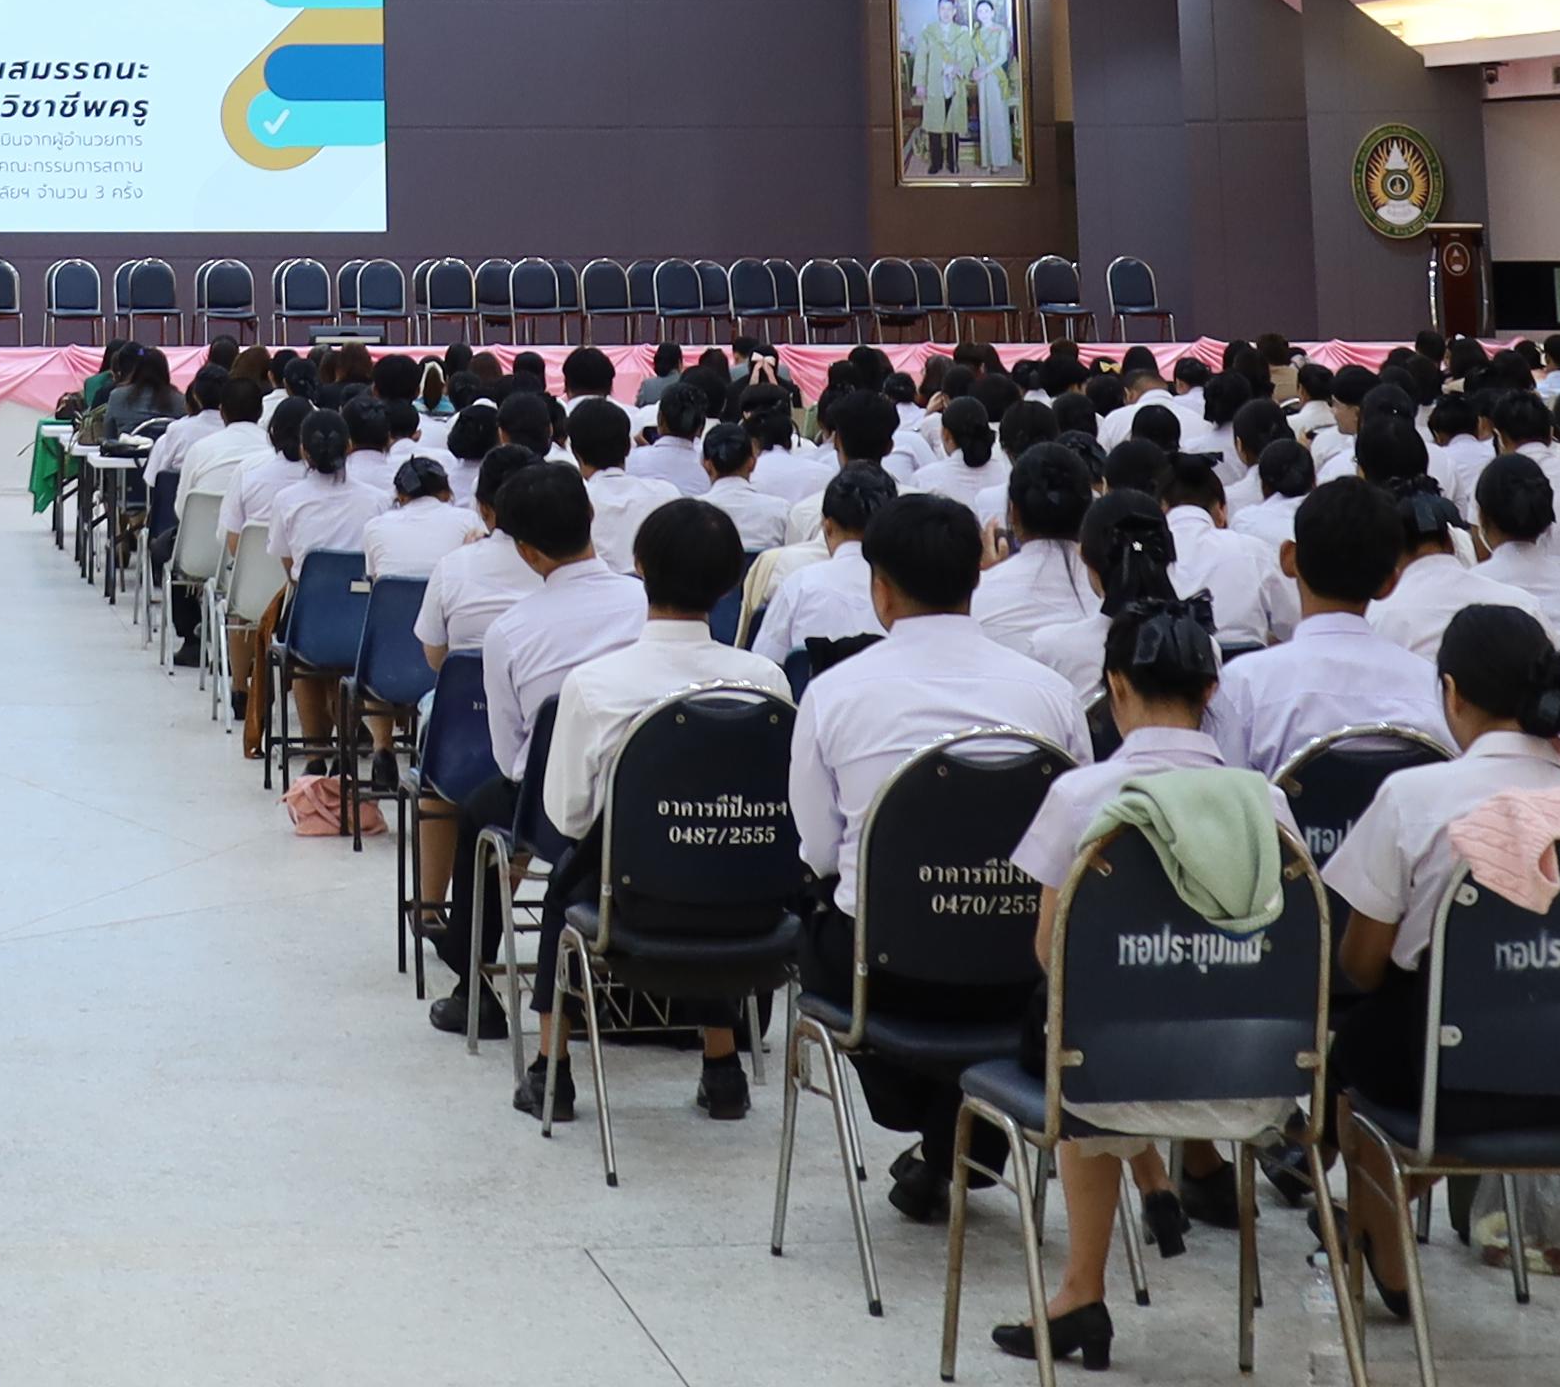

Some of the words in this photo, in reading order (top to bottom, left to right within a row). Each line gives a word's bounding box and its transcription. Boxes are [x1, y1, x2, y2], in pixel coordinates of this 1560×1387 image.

[37, 183, 87, 199] จำนวน
[95, 185, 104, 199] 3
[658, 794, 787, 818] อาคารทีปังกรฯ
[669, 826, 776, 844] 0487/2555
[931, 894, 1040, 915] 0470/255
